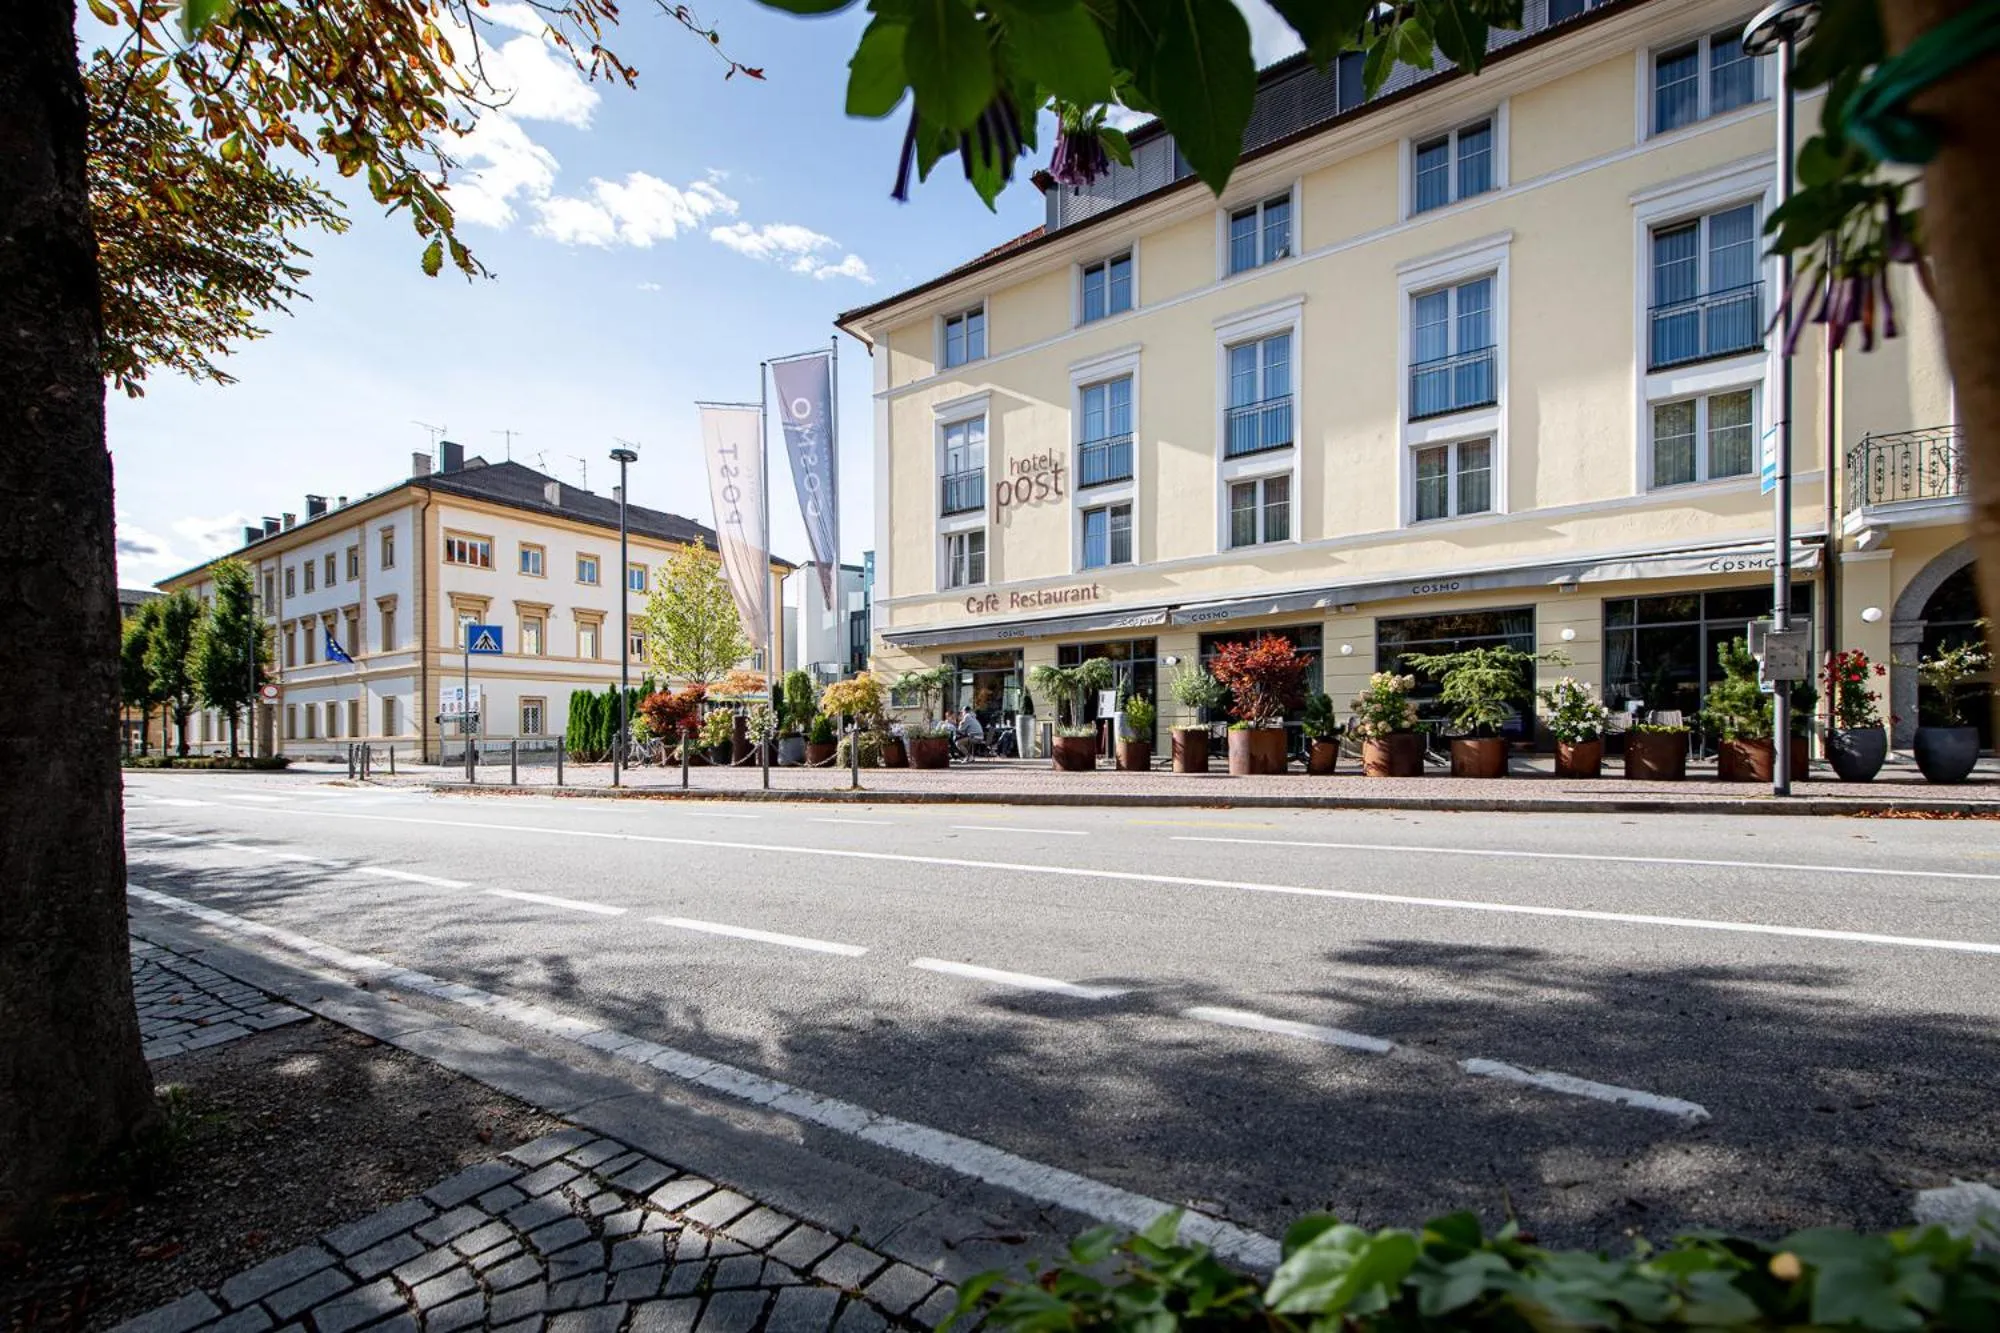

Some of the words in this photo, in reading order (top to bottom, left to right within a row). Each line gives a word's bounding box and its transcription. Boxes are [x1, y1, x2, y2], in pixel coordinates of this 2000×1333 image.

[1010, 448, 1053, 476] hotel
[996, 462, 1064, 525] post
[1010, 583, 1100, 609] Restaurant
[1412, 582, 1460, 594] COSMO
[1191, 611, 1229, 621] COSMO
[997, 630, 1025, 638] COSMO
